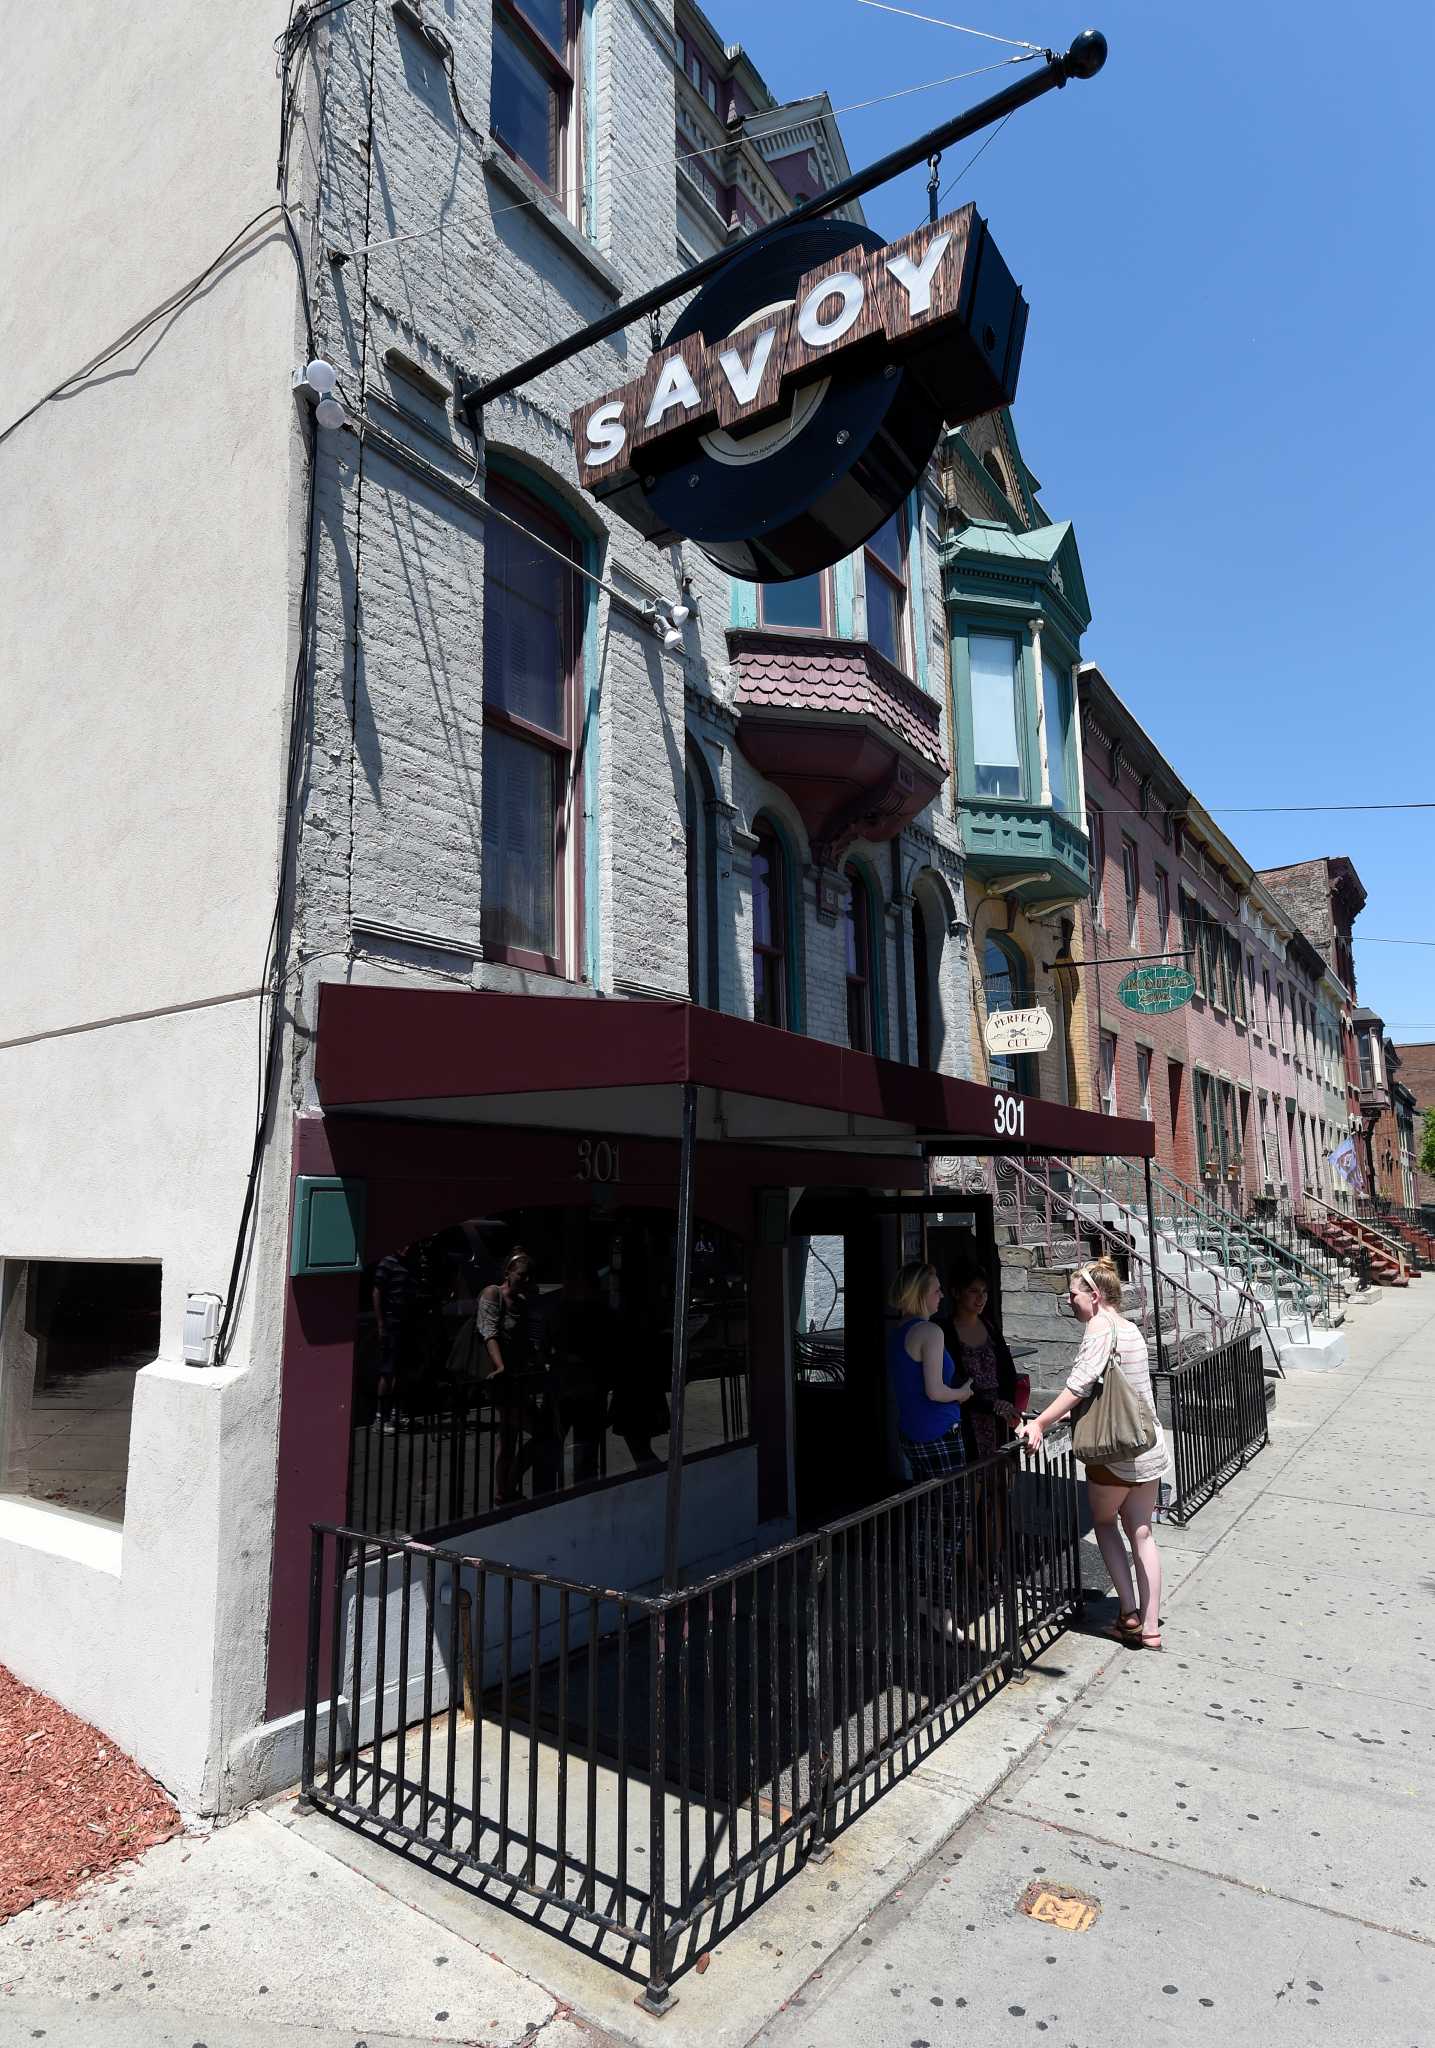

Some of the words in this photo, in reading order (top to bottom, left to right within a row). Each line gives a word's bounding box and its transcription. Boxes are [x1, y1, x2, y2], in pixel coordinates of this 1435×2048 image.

[584, 230, 953, 467] SAVOY
[994, 1014, 1042, 1029] PERFECT
[1007, 1038, 1028, 1048] CUT
[994, 1094, 1025, 1136] 301
[576, 1138, 624, 1183] 301
